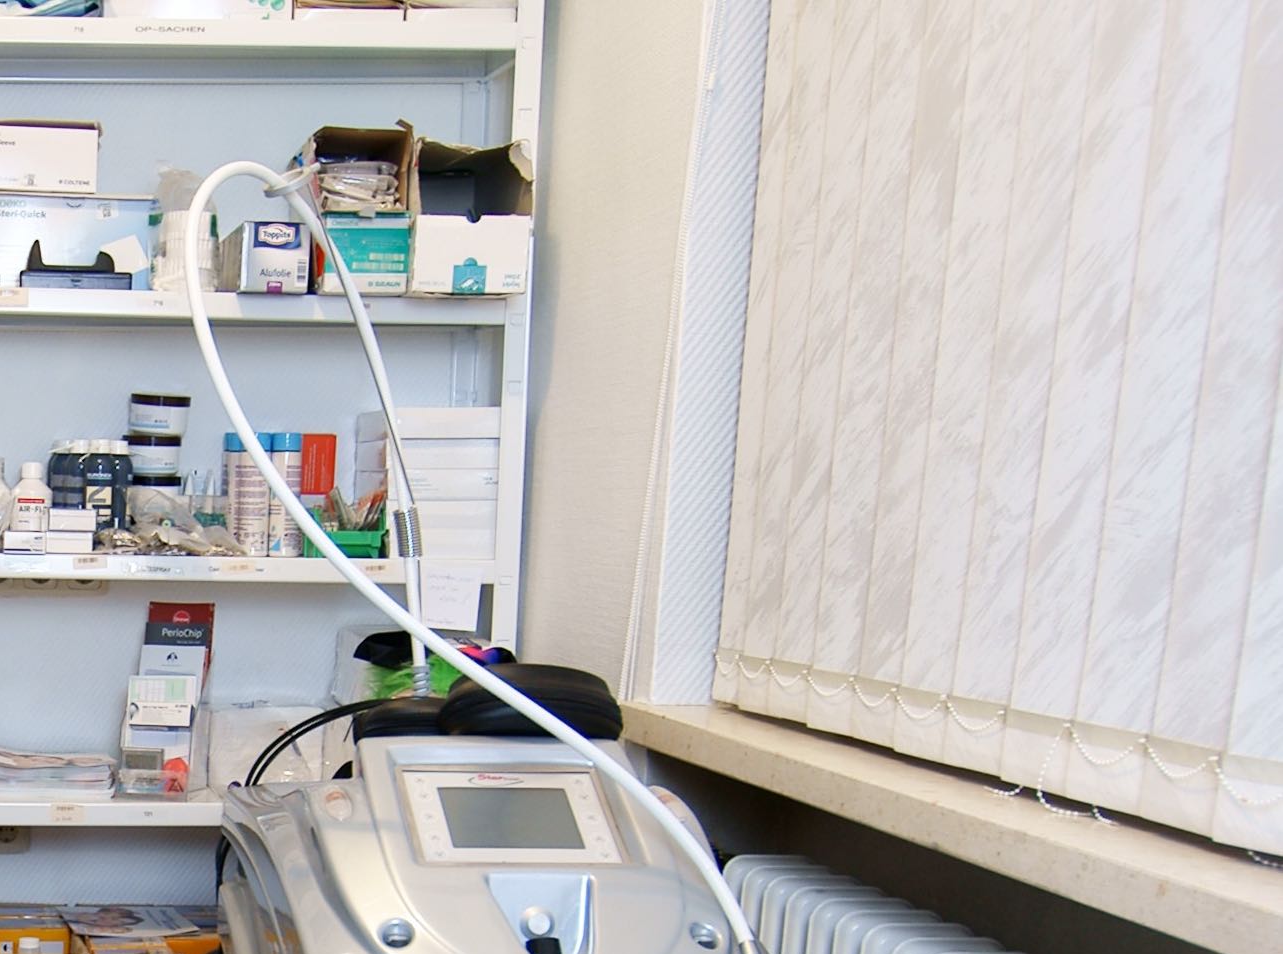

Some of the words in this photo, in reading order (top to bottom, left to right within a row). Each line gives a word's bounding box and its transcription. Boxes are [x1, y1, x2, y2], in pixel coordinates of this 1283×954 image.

[134, 25, 206, 34] OP-SACHEN
[261, 230, 292, 242] Toppits
[259, 268, 292, 279] Alufolie
